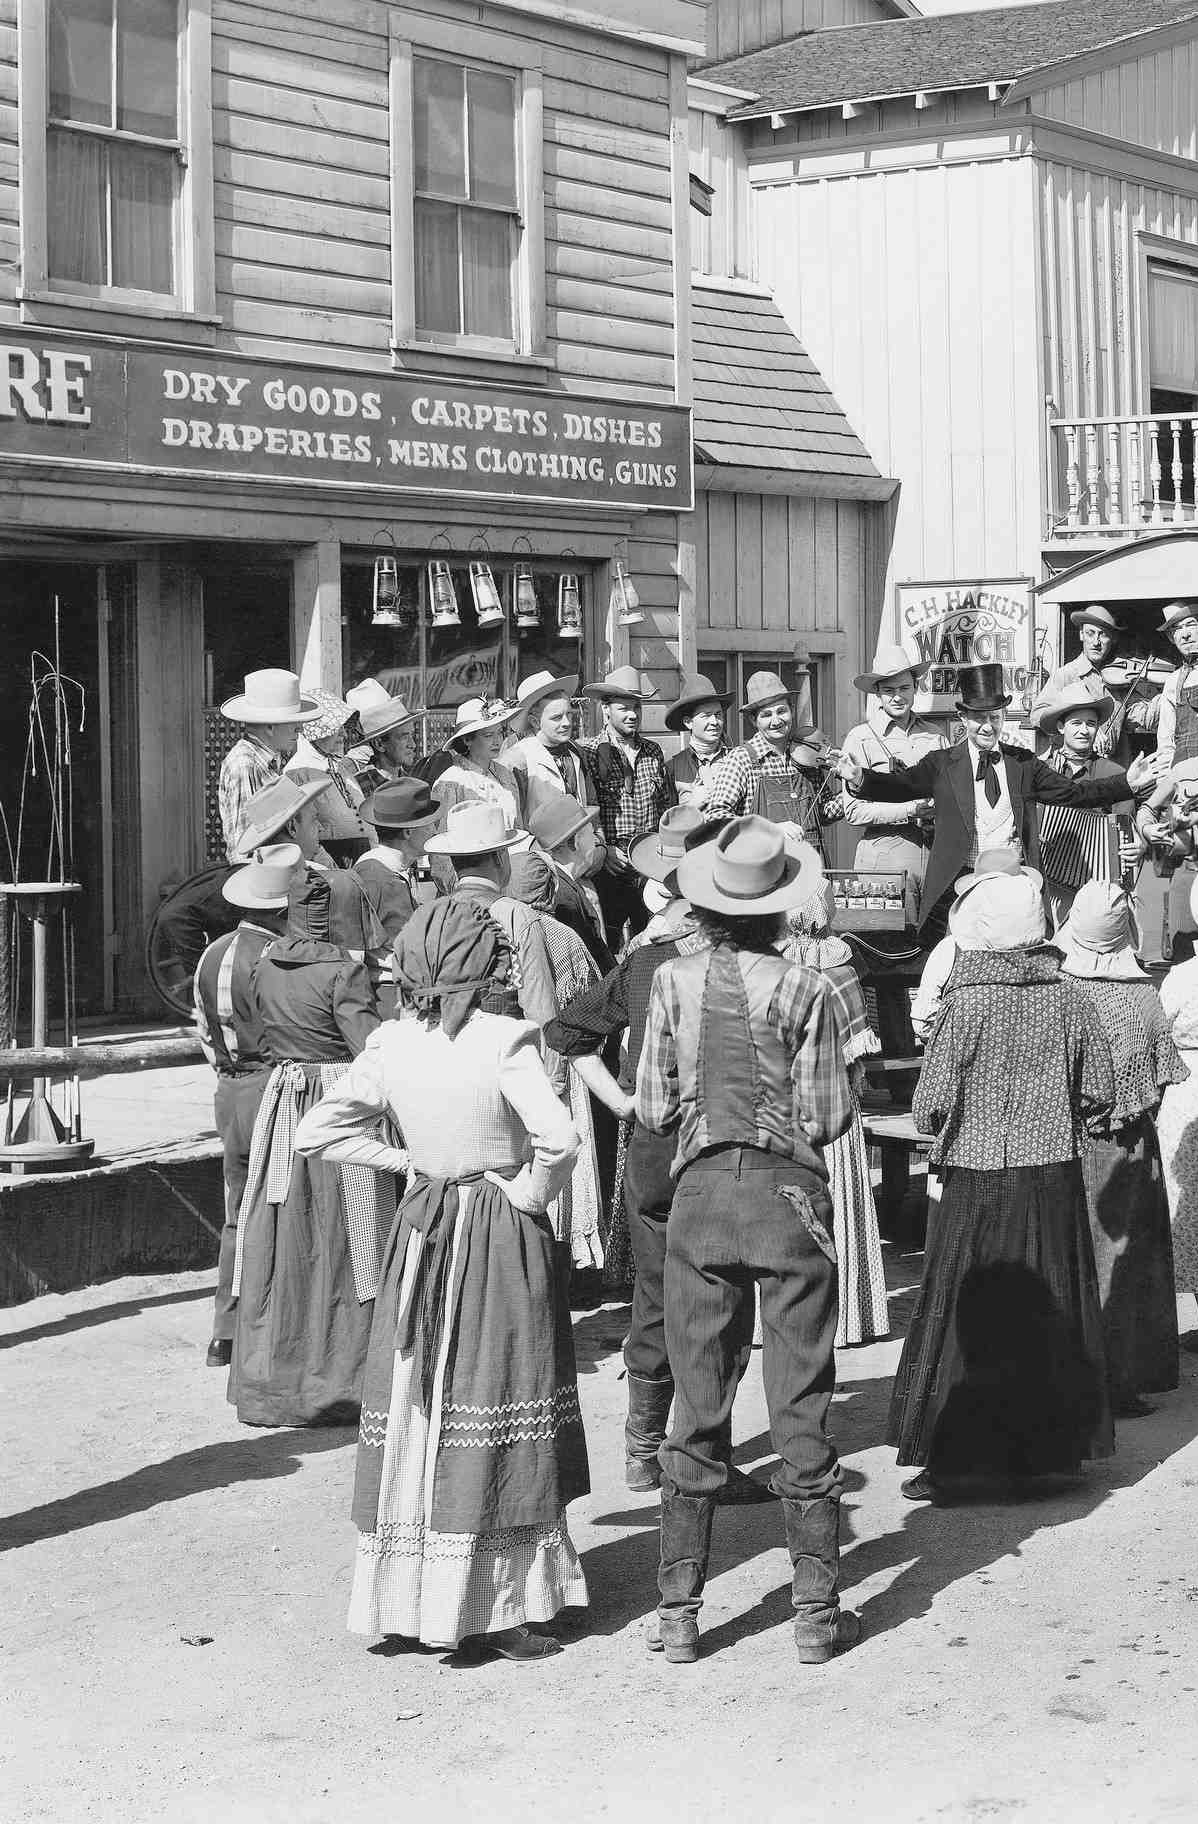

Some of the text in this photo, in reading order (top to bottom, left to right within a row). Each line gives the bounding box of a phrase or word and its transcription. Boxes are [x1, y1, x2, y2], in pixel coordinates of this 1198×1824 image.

[163, 369, 251, 406] DRY
[411, 397, 559, 441] CARPETS,
[562, 412, 663, 448] DISHES
[161, 417, 678, 489] DRAPERIES, MENS CLOTHING, GUNS
[912, 624, 1018, 664] WATCH
